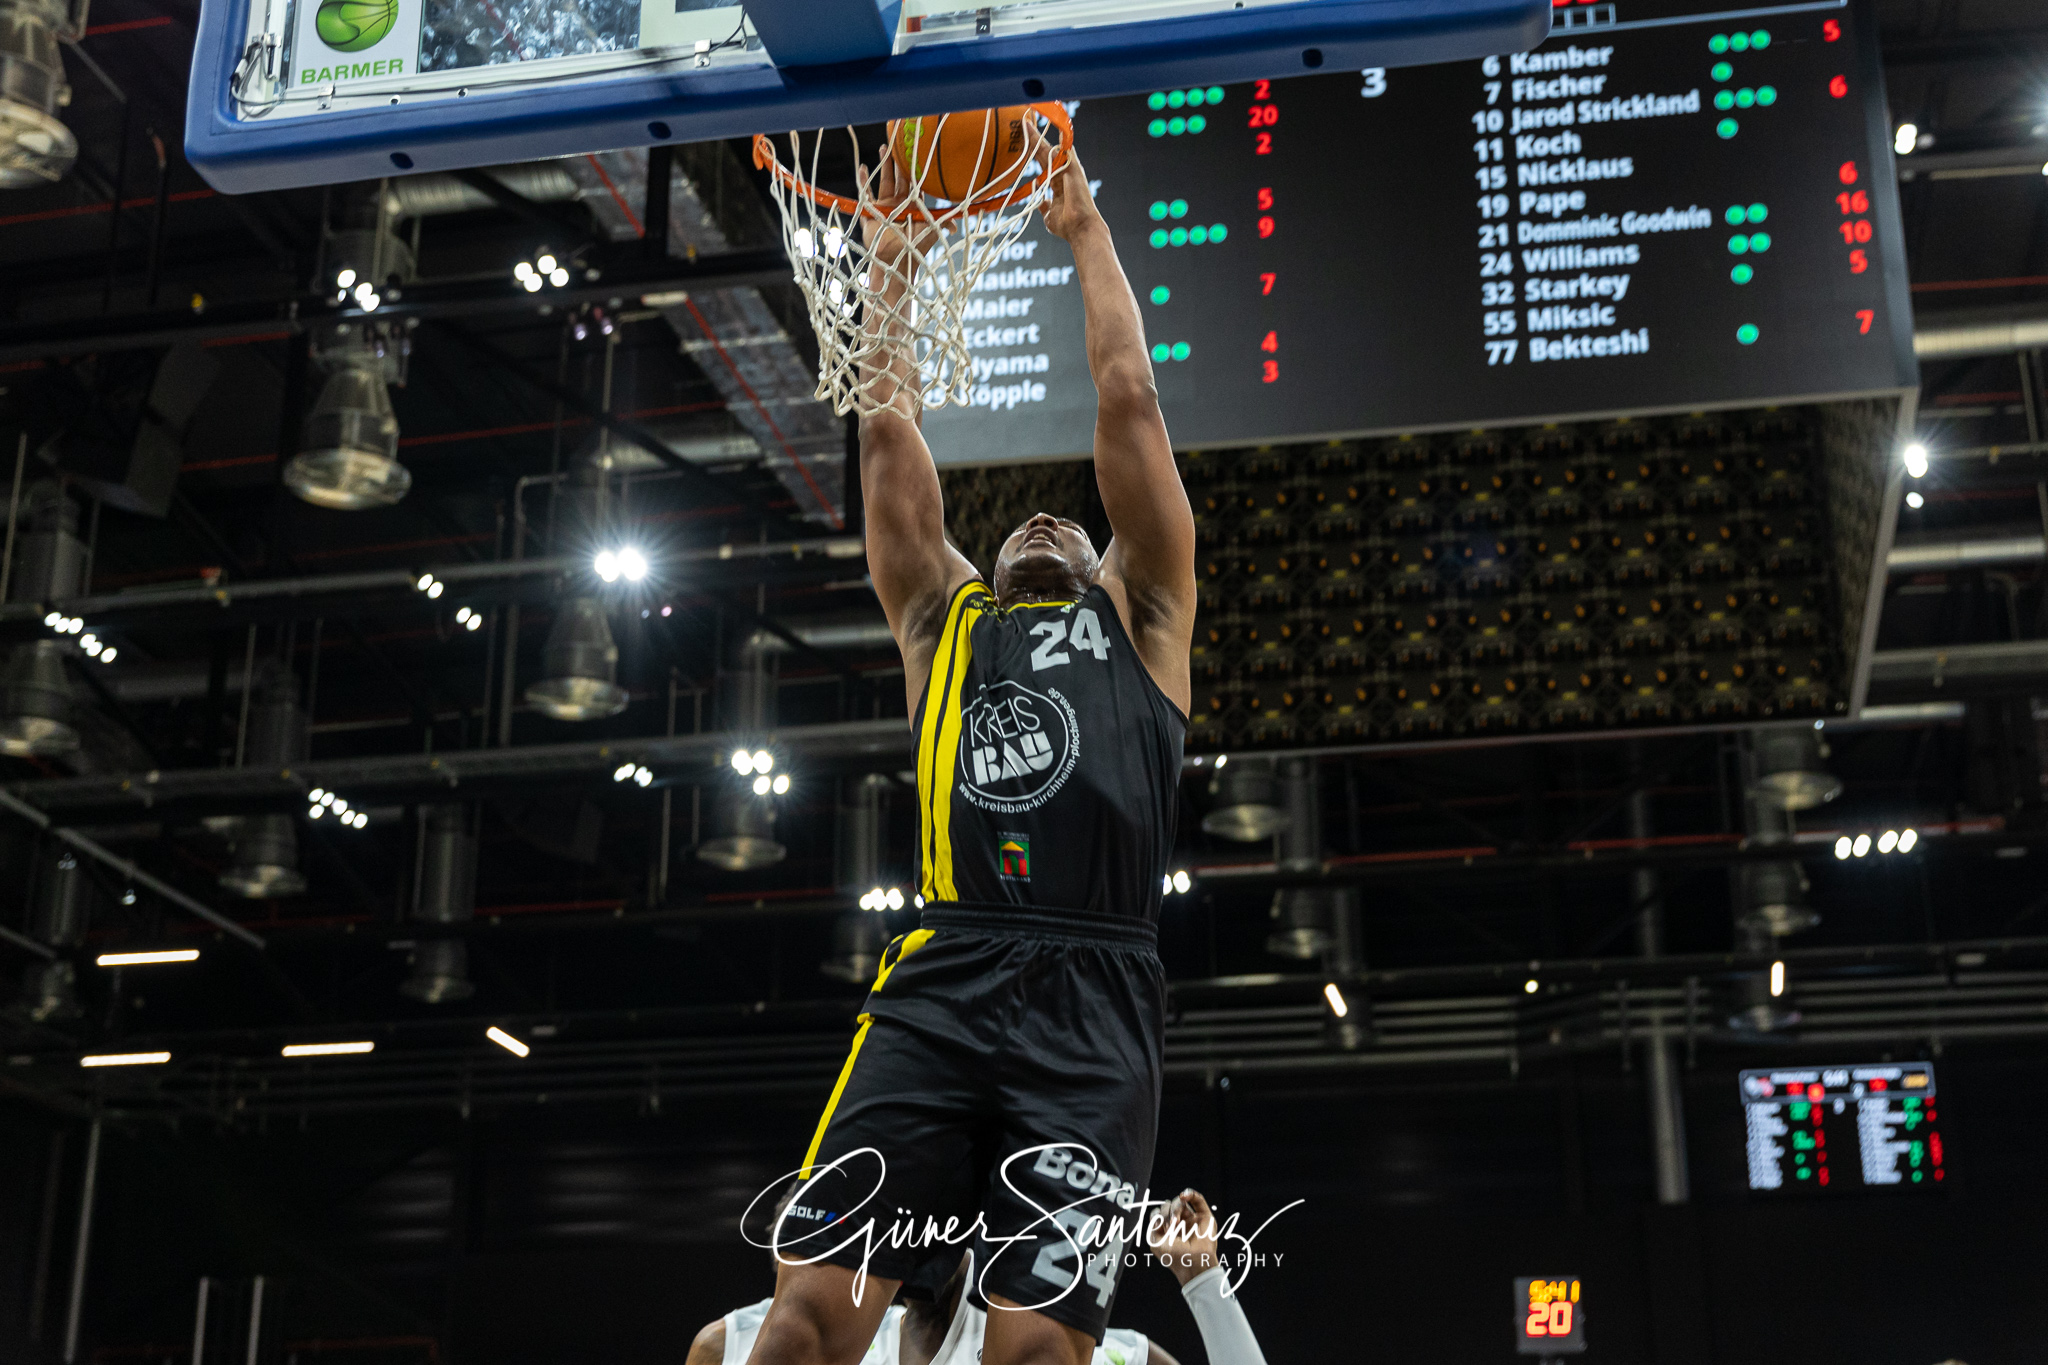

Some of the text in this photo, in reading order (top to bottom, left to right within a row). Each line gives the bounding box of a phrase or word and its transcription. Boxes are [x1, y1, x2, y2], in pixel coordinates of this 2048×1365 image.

[1824, 20, 1840, 41] 5
[301, 58, 404, 84] BARMER
[1483, 46, 1613, 76] 6 Kamber
[1255, 79, 1269, 99] 2
[1362, 67, 1386, 97] 3
[1484, 75, 1606, 104] 7 Fischer
[1830, 76, 1847, 98] 6
[1249, 105, 1278, 127] 20
[1473, 90, 1699, 134] 10 Jarod Strickland
[1257, 133, 1271, 154] 2
[1474, 131, 1581, 161] 11 Koch
[1476, 158, 1633, 189] 15 Nicklaus
[1839, 162, 1857, 184] 6
[1258, 188, 1273, 210] 5
[1478, 191, 1585, 218] 19 Pape
[1836, 190, 1869, 214] 16
[1258, 217, 1274, 238] 9
[1479, 224, 1508, 247] 21
[1622, 206, 1711, 234] Goodwin
[1840, 220, 1872, 244] 10
[1481, 245, 1639, 276] 24 Williams
[1850, 250, 1867, 273] 5
[1261, 273, 1276, 295] 7
[1482, 274, 1629, 305] 32 Starkey
[962, 296, 1034, 322] Maier
[1484, 303, 1615, 335] 55 Miksic
[1856, 310, 1874, 334] 7
[963, 322, 1040, 350] Eckert
[1262, 331, 1278, 352] 4
[1485, 328, 1649, 365] 77 Bekteshi
[1263, 360, 1278, 382] 3
[1029, 608, 1111, 672] 24
[969, 695, 1041, 748] KREIS
[972, 730, 1053, 786] BAU
[1031, 1208, 1123, 1308] 24
[1526, 1301, 1573, 1337] 20
